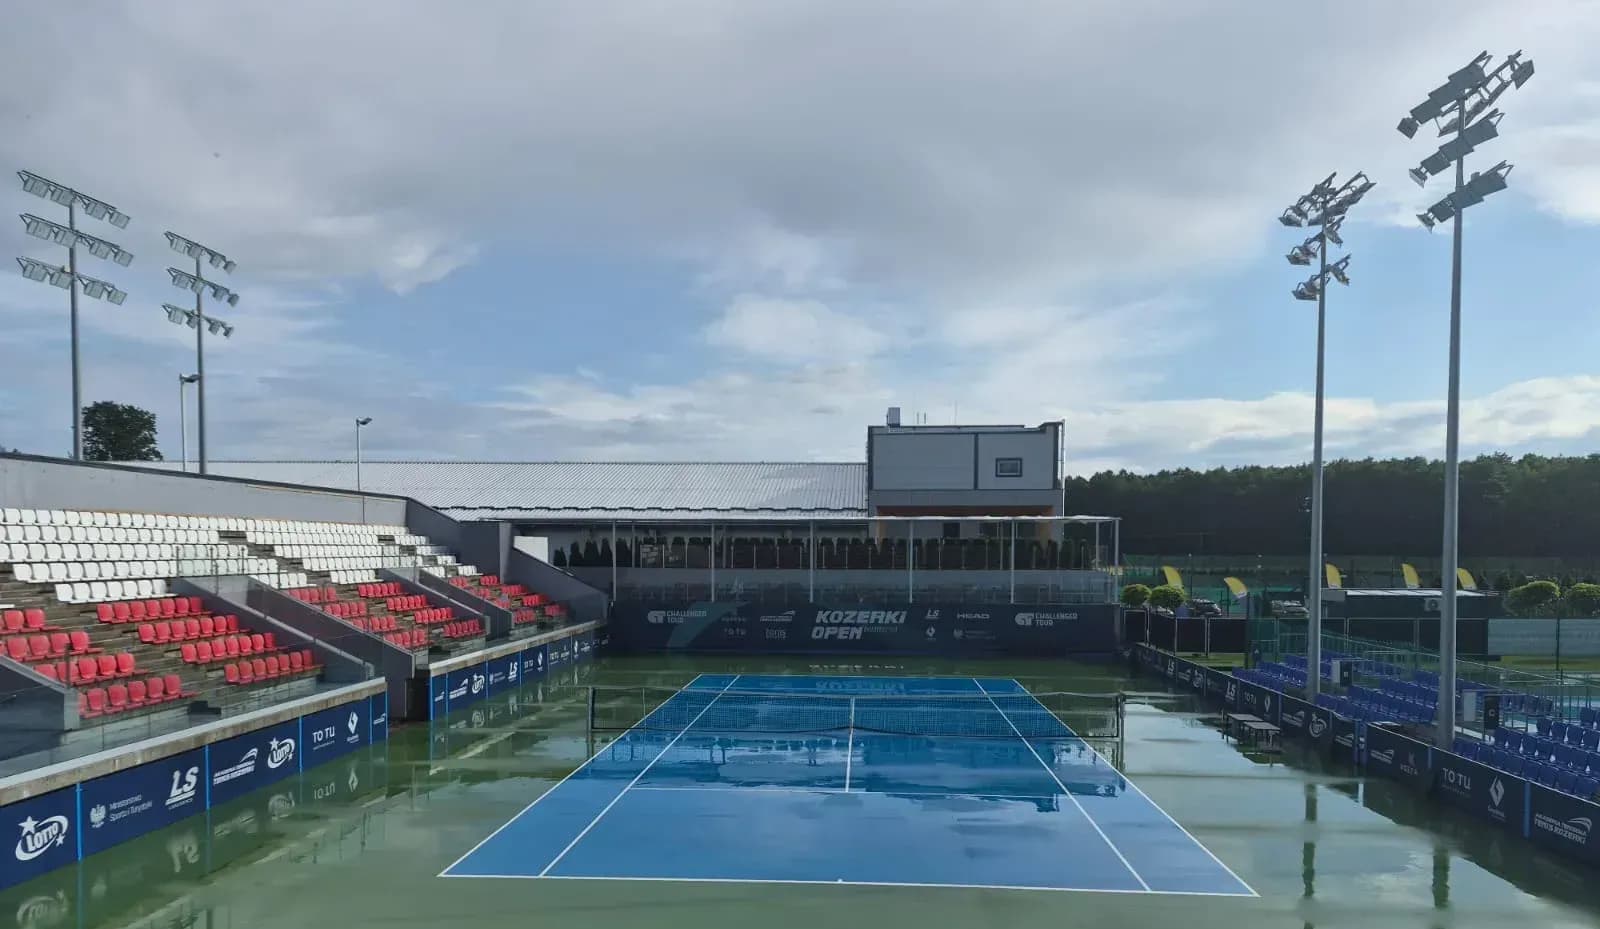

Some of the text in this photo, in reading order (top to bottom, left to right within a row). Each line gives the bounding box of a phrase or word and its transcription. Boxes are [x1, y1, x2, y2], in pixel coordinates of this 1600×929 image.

[815, 610, 908, 624] KOZERKI
[811, 626, 863, 640] OPEN
[312, 730, 323, 743] TO
[325, 726, 336, 739] TU
[170, 766, 199, 798] LS
[1442, 767, 1471, 790] TO TU
[26, 822, 59, 853] LOTTO
